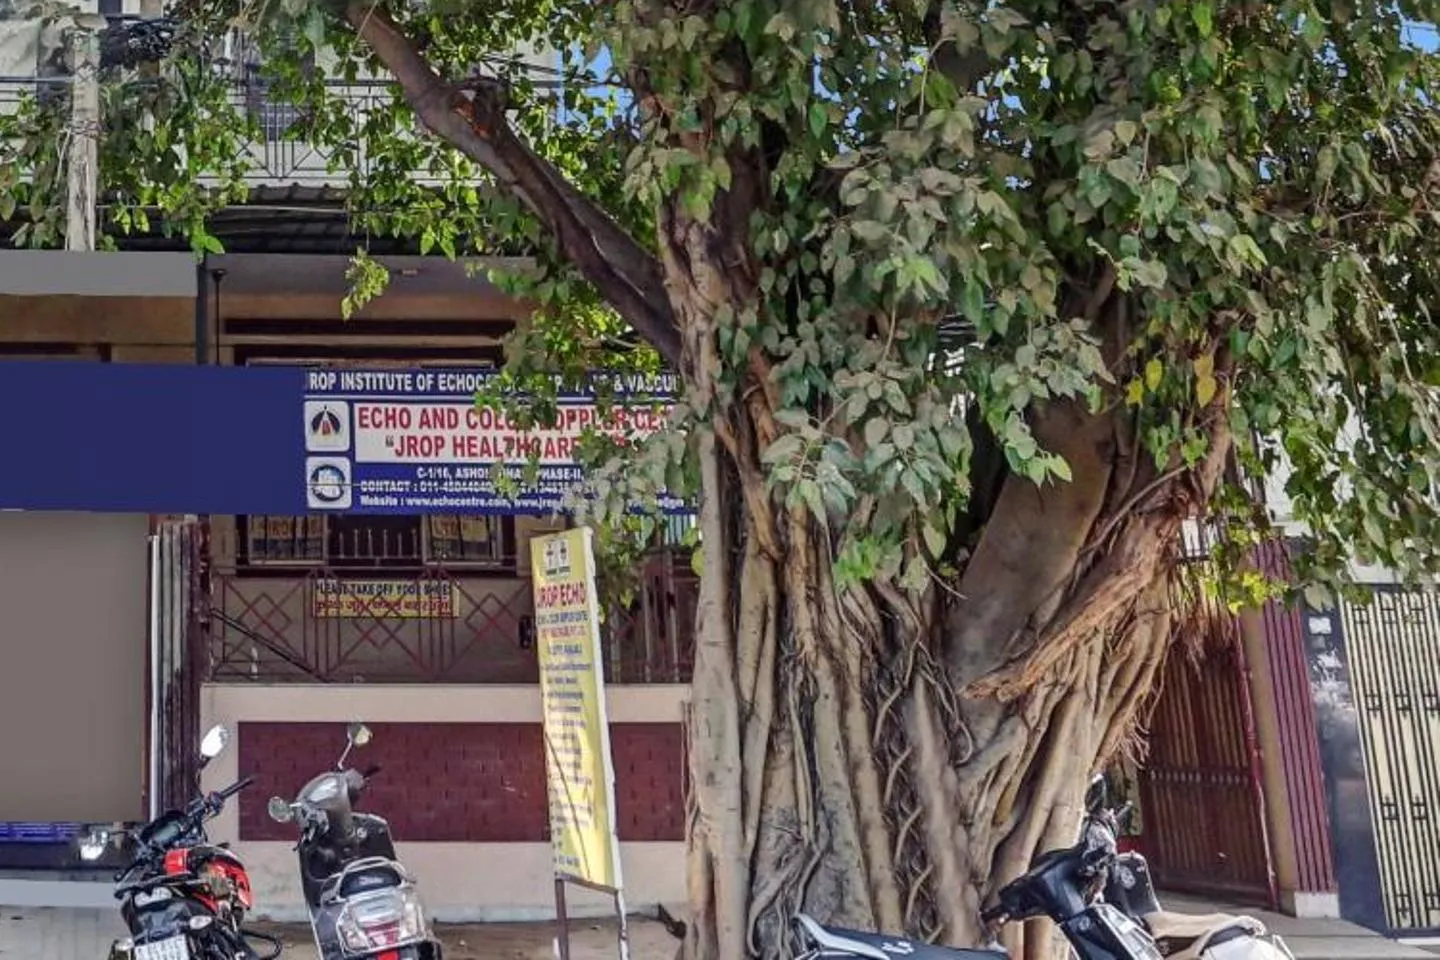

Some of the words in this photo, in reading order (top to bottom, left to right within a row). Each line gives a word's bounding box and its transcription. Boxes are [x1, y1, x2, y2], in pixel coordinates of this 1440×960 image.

[340, 373, 412, 391] INSTITUTE
[416, 374, 435, 391] OF
[358, 406, 412, 429] ECHO
[418, 407, 459, 430] AND
[360, 480, 411, 493] CONTACT
